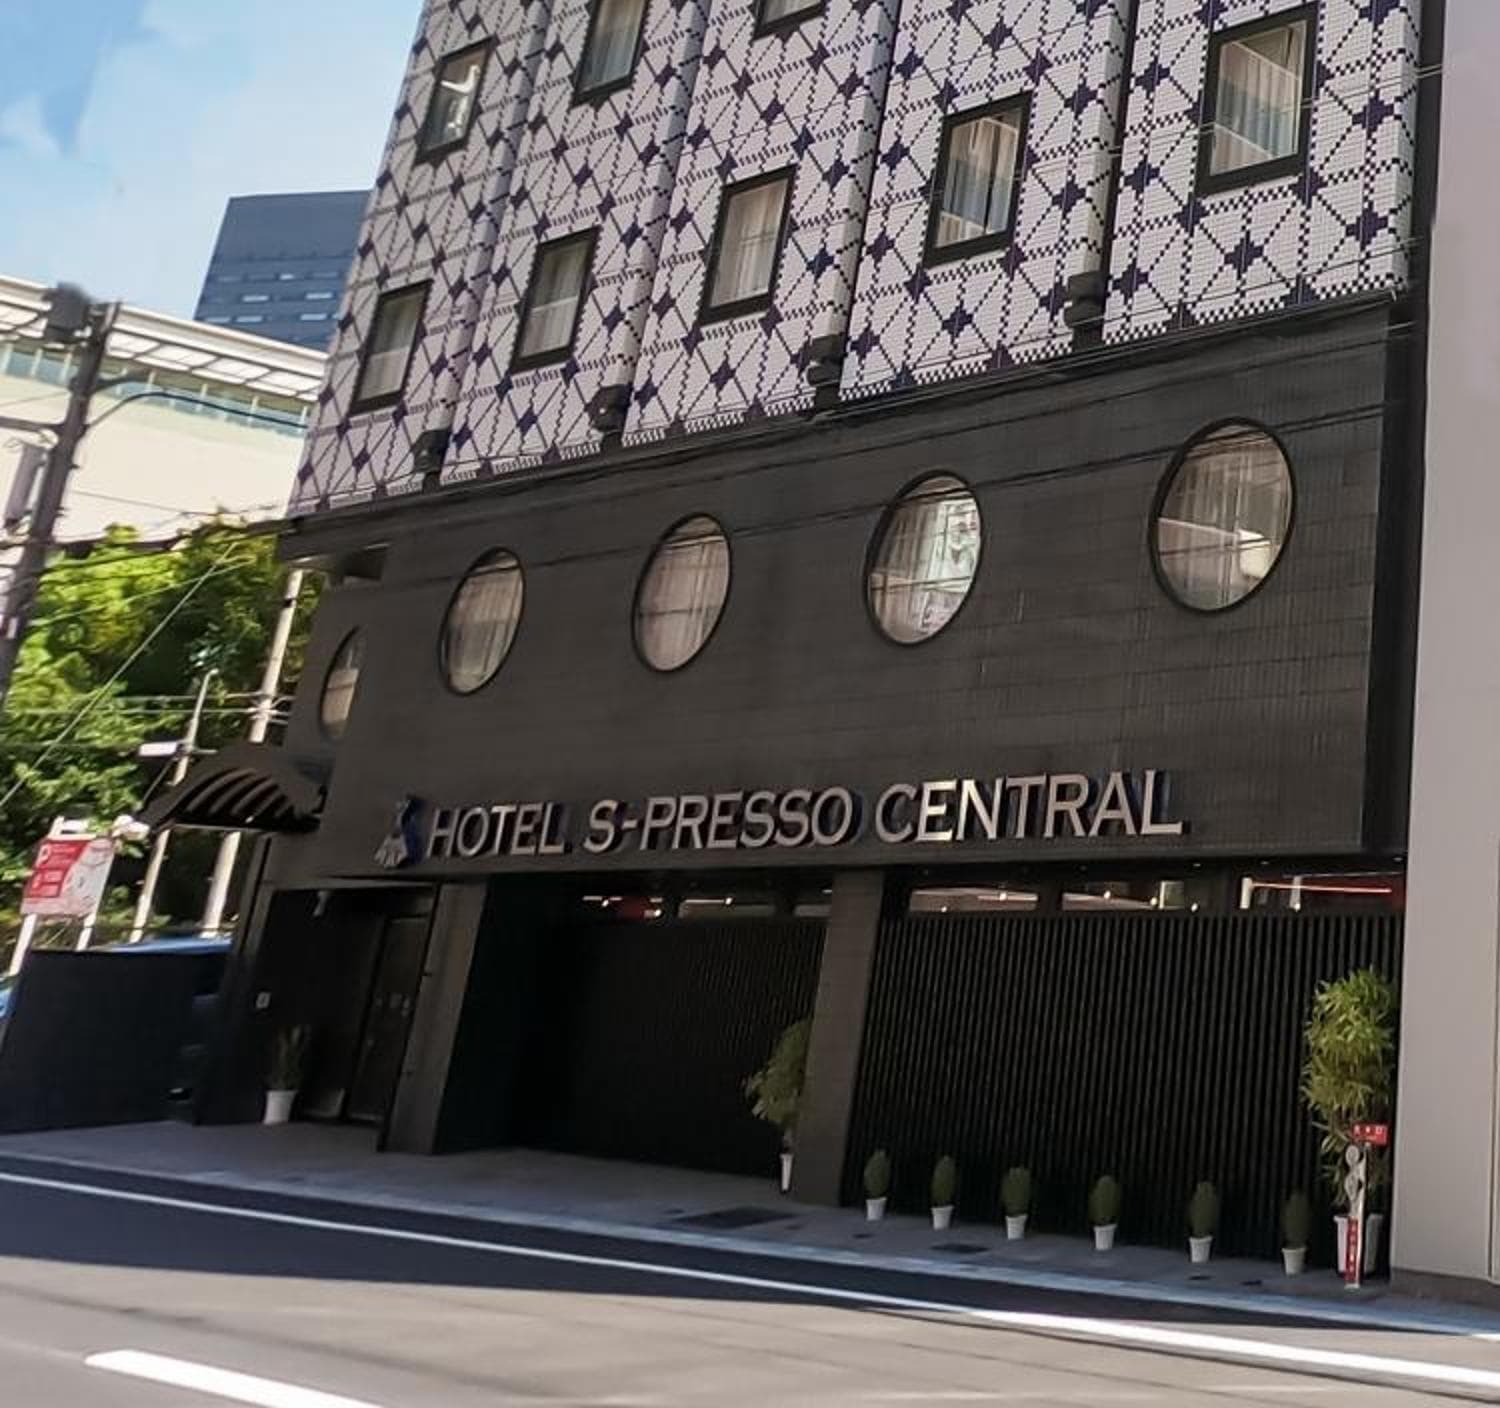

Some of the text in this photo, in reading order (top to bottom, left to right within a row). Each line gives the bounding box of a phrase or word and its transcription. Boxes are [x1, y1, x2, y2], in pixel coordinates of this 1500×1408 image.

[425, 769, 1184, 859] HOTEL S-PRESSO CENTRAL
